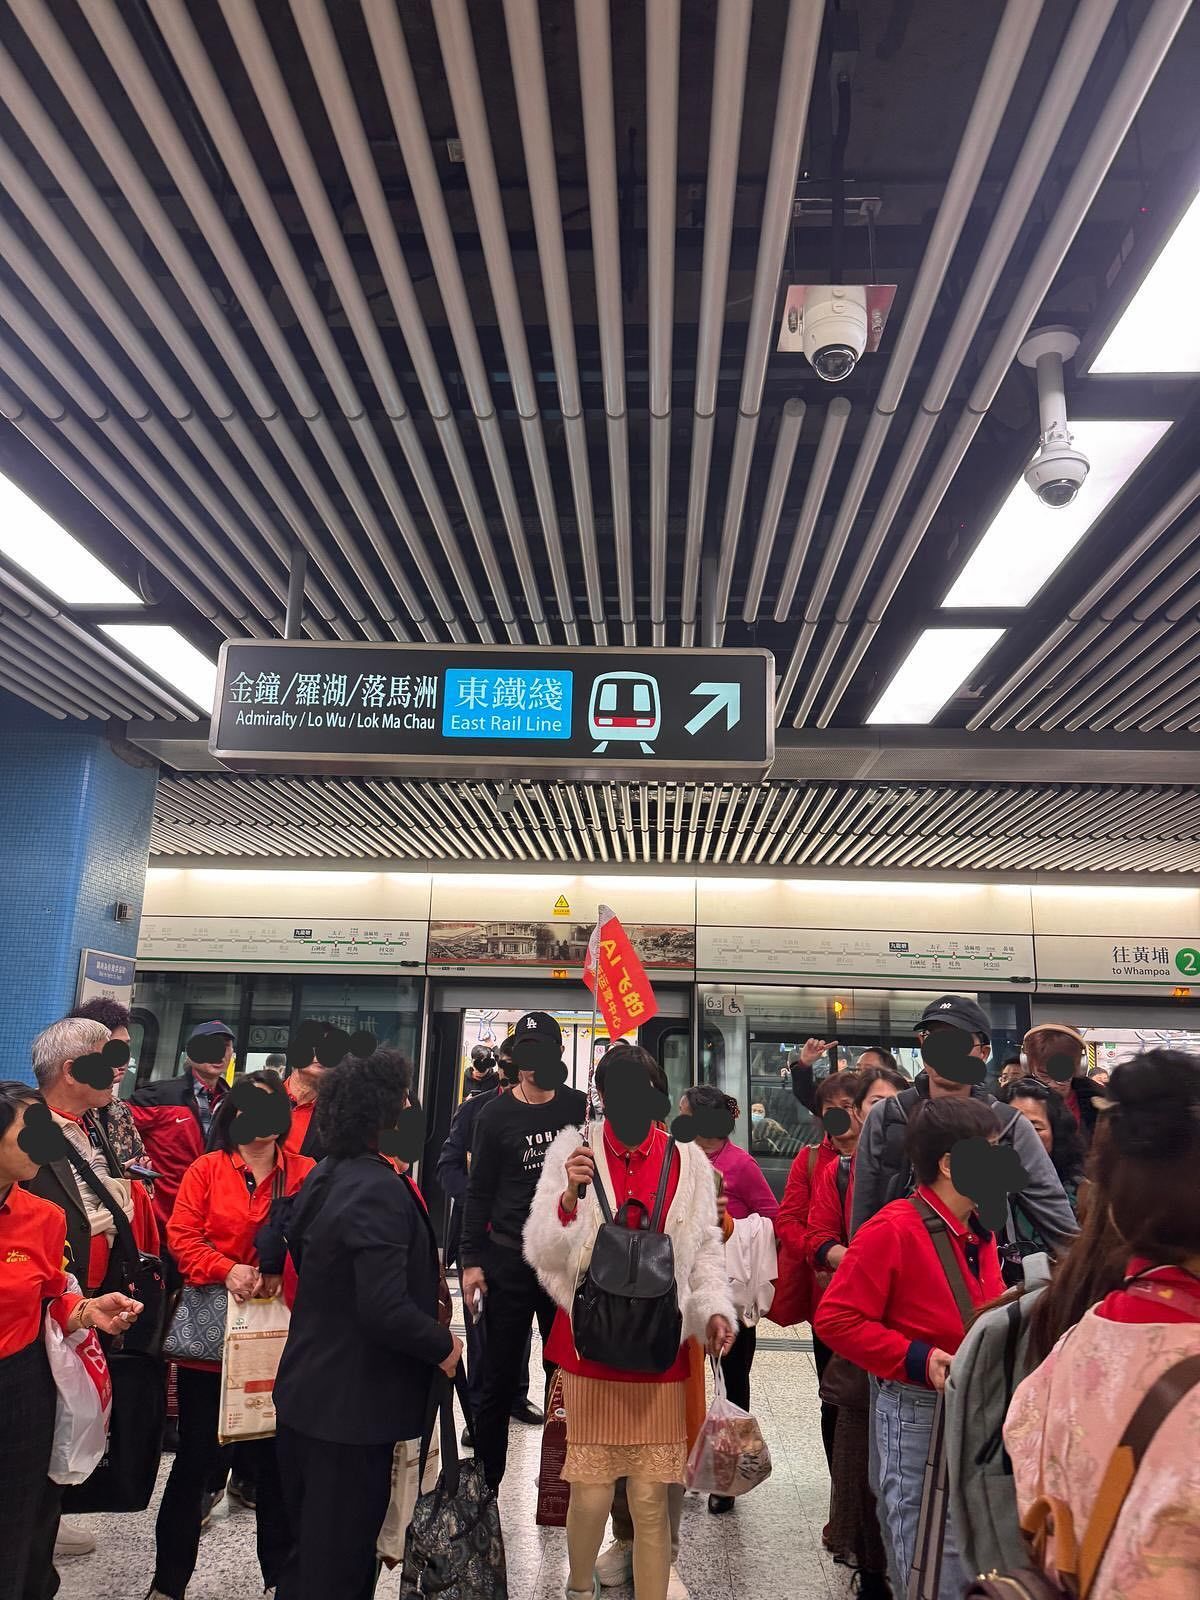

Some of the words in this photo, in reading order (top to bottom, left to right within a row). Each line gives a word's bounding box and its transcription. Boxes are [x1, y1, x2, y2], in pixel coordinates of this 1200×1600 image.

[228, 671, 438, 709] 金鐘/羅湖/落馬洲
[235, 710, 297, 730] Admiralty
[308, 711, 323, 727] Lo
[326, 712, 346, 728] Wu
[357, 711, 379, 729] Lok
[382, 713, 401, 729] Ma
[403, 712, 436, 730] Chau
[451, 715, 486, 730] East
[490, 715, 521, 731] Rail
[526, 716, 562, 732] Line
[1183, 952, 1197, 971] 2
[1112, 967, 1122, 975] to
[1123, 966, 1171, 977] Whampoa
[526, 1016, 537, 1029] LA
[526, 1130, 560, 1145] YOH
